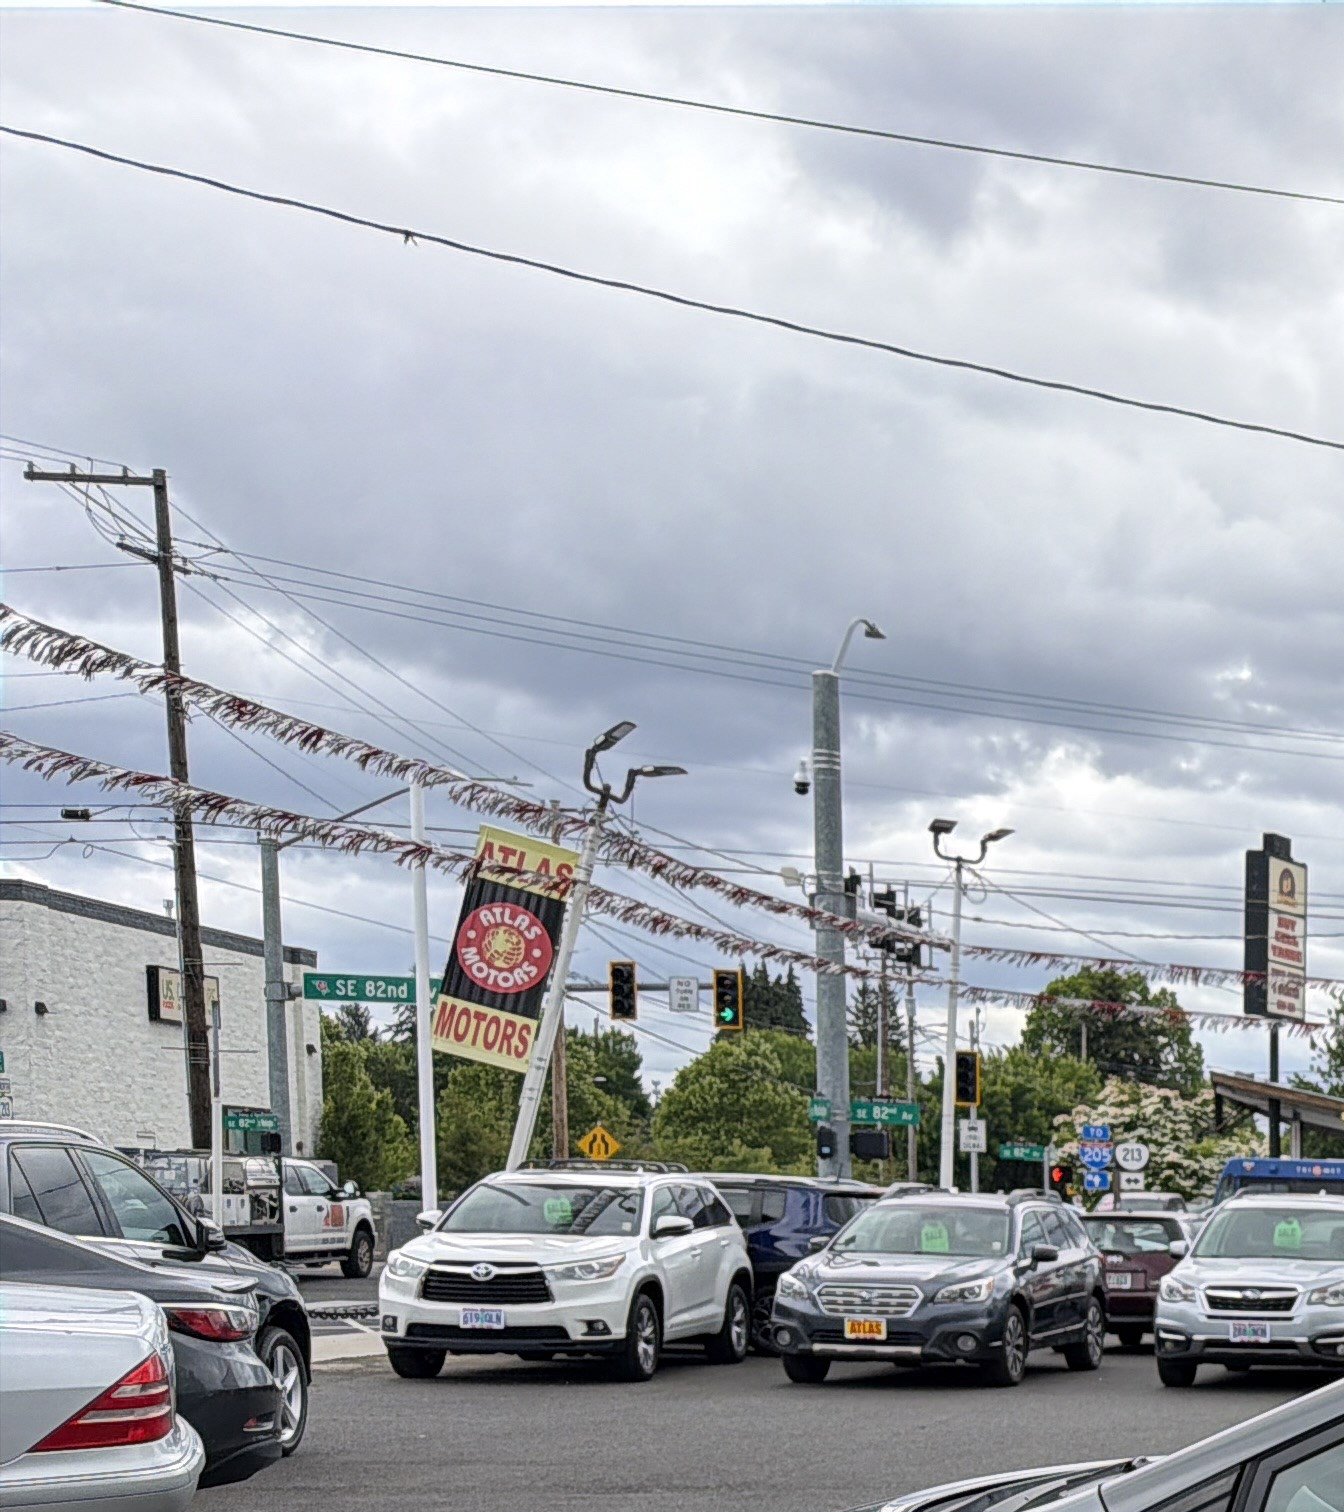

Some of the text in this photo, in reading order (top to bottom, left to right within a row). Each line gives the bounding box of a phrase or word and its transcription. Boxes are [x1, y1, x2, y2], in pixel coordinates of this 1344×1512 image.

[480, 841, 573, 893] ATLAS
[480, 907, 542, 939] ATLAS
[461, 946, 538, 988] MOTORS
[335, 979, 357, 997] SE
[365, 980, 408, 999] 82nd
[433, 1000, 532, 1059] MOTORS
[873, 1105, 897, 1120] 82nd
[1084, 1147, 1111, 1163] 205
[1122, 1147, 1142, 1162] 213
[850, 1322, 882, 1336] ATLAS
